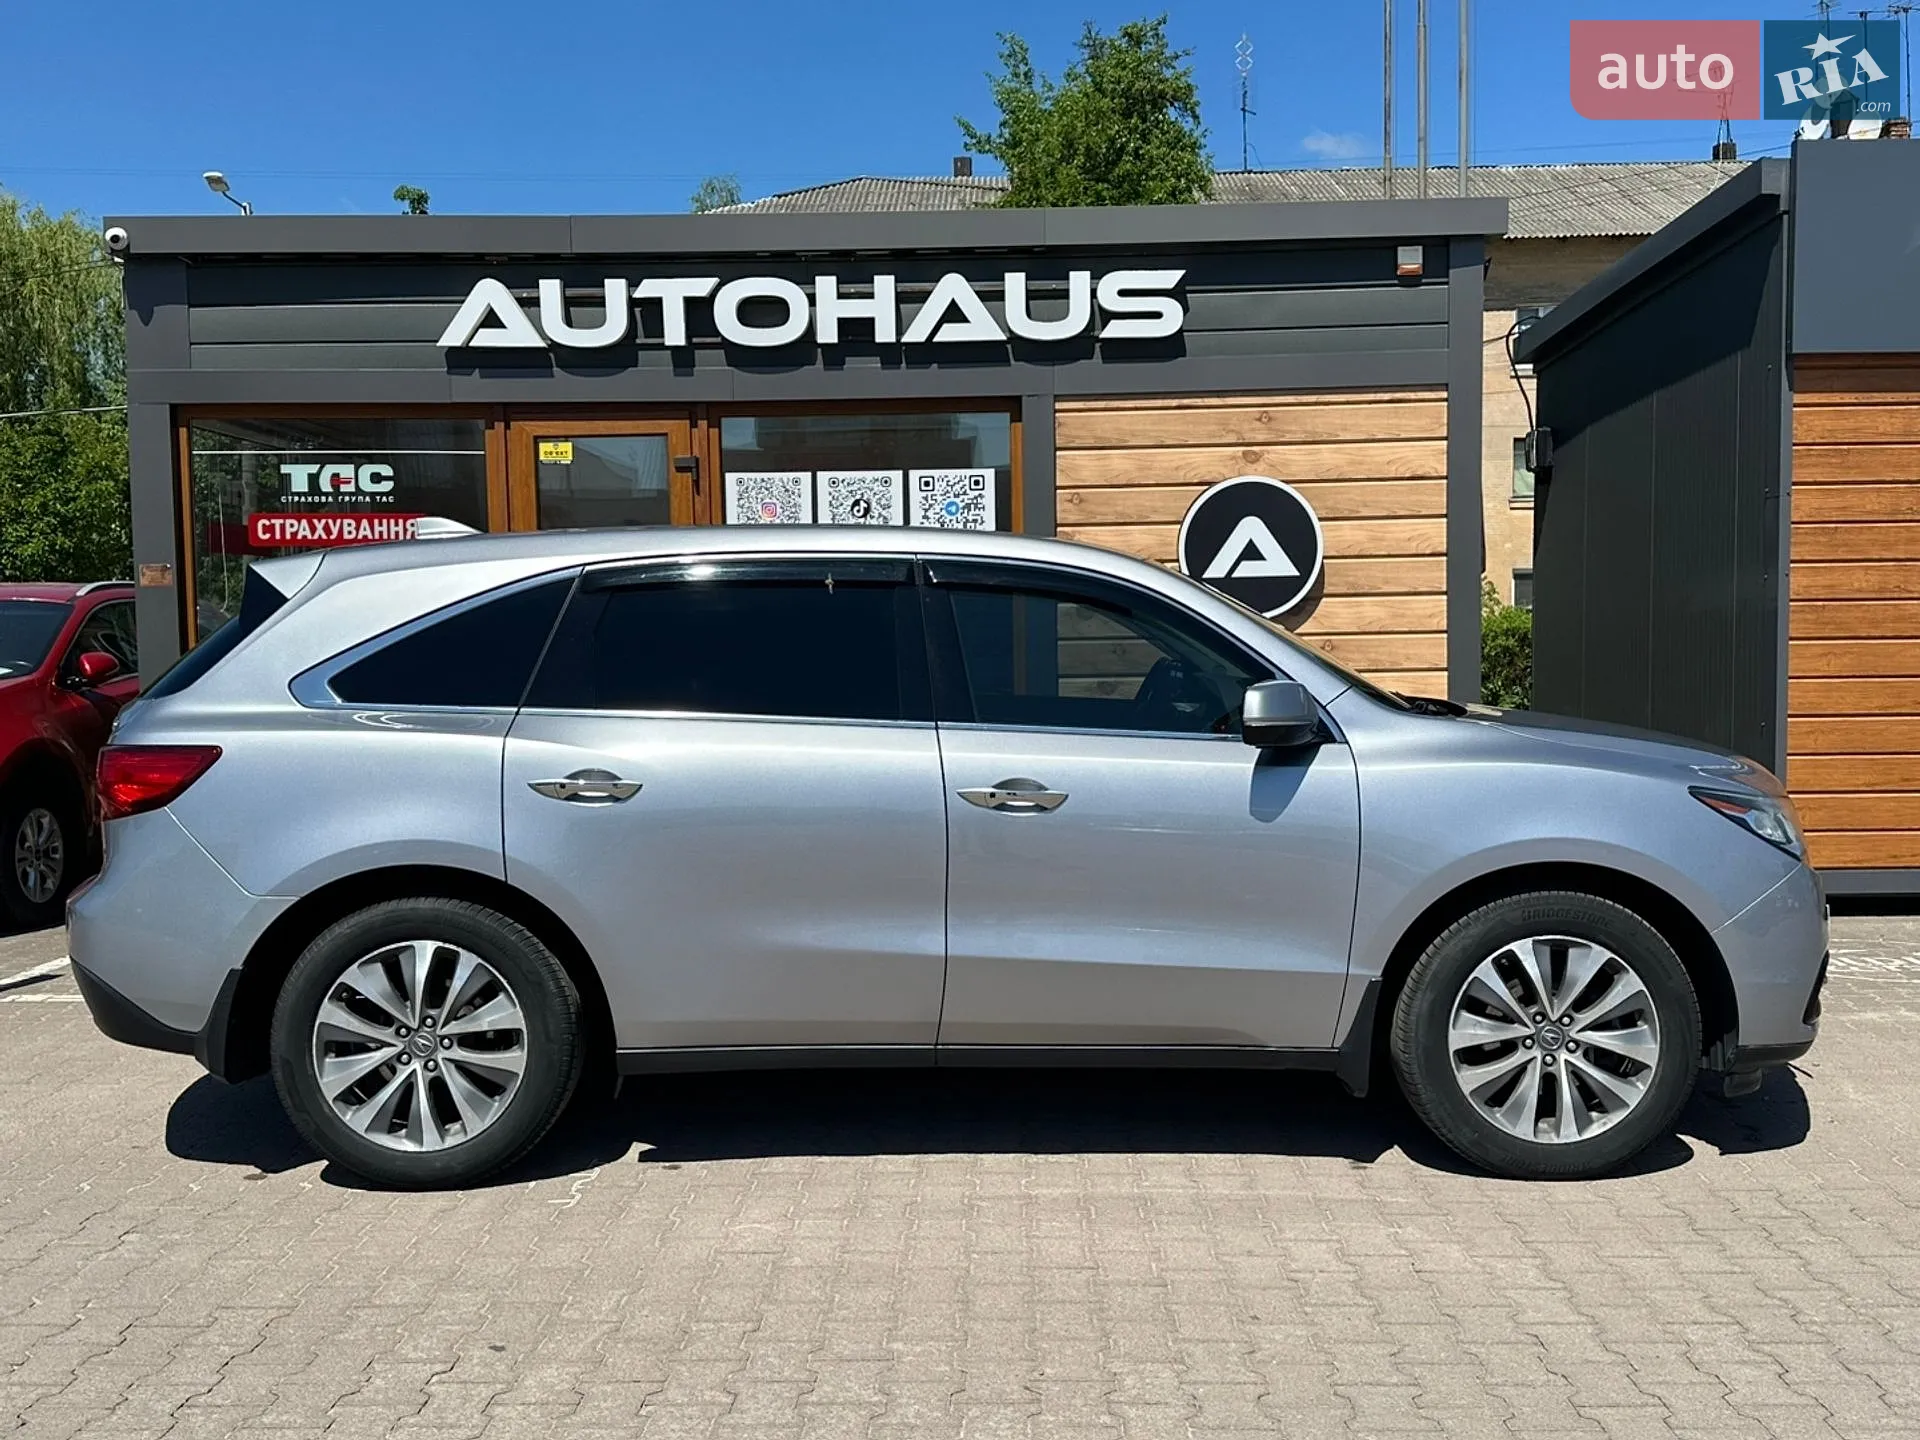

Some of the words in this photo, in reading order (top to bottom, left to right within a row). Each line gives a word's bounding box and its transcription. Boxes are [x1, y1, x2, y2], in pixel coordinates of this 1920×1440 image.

[436, 268, 1187, 348] AUTOHAUS
[280, 464, 395, 492] ТАС
[280, 495, 334, 503] СТРАХОВА
[338, 495, 371, 503] ГРУПА
[375, 495, 395, 503] ТАС
[257, 518, 418, 540] СТРАХУВАННЯ
